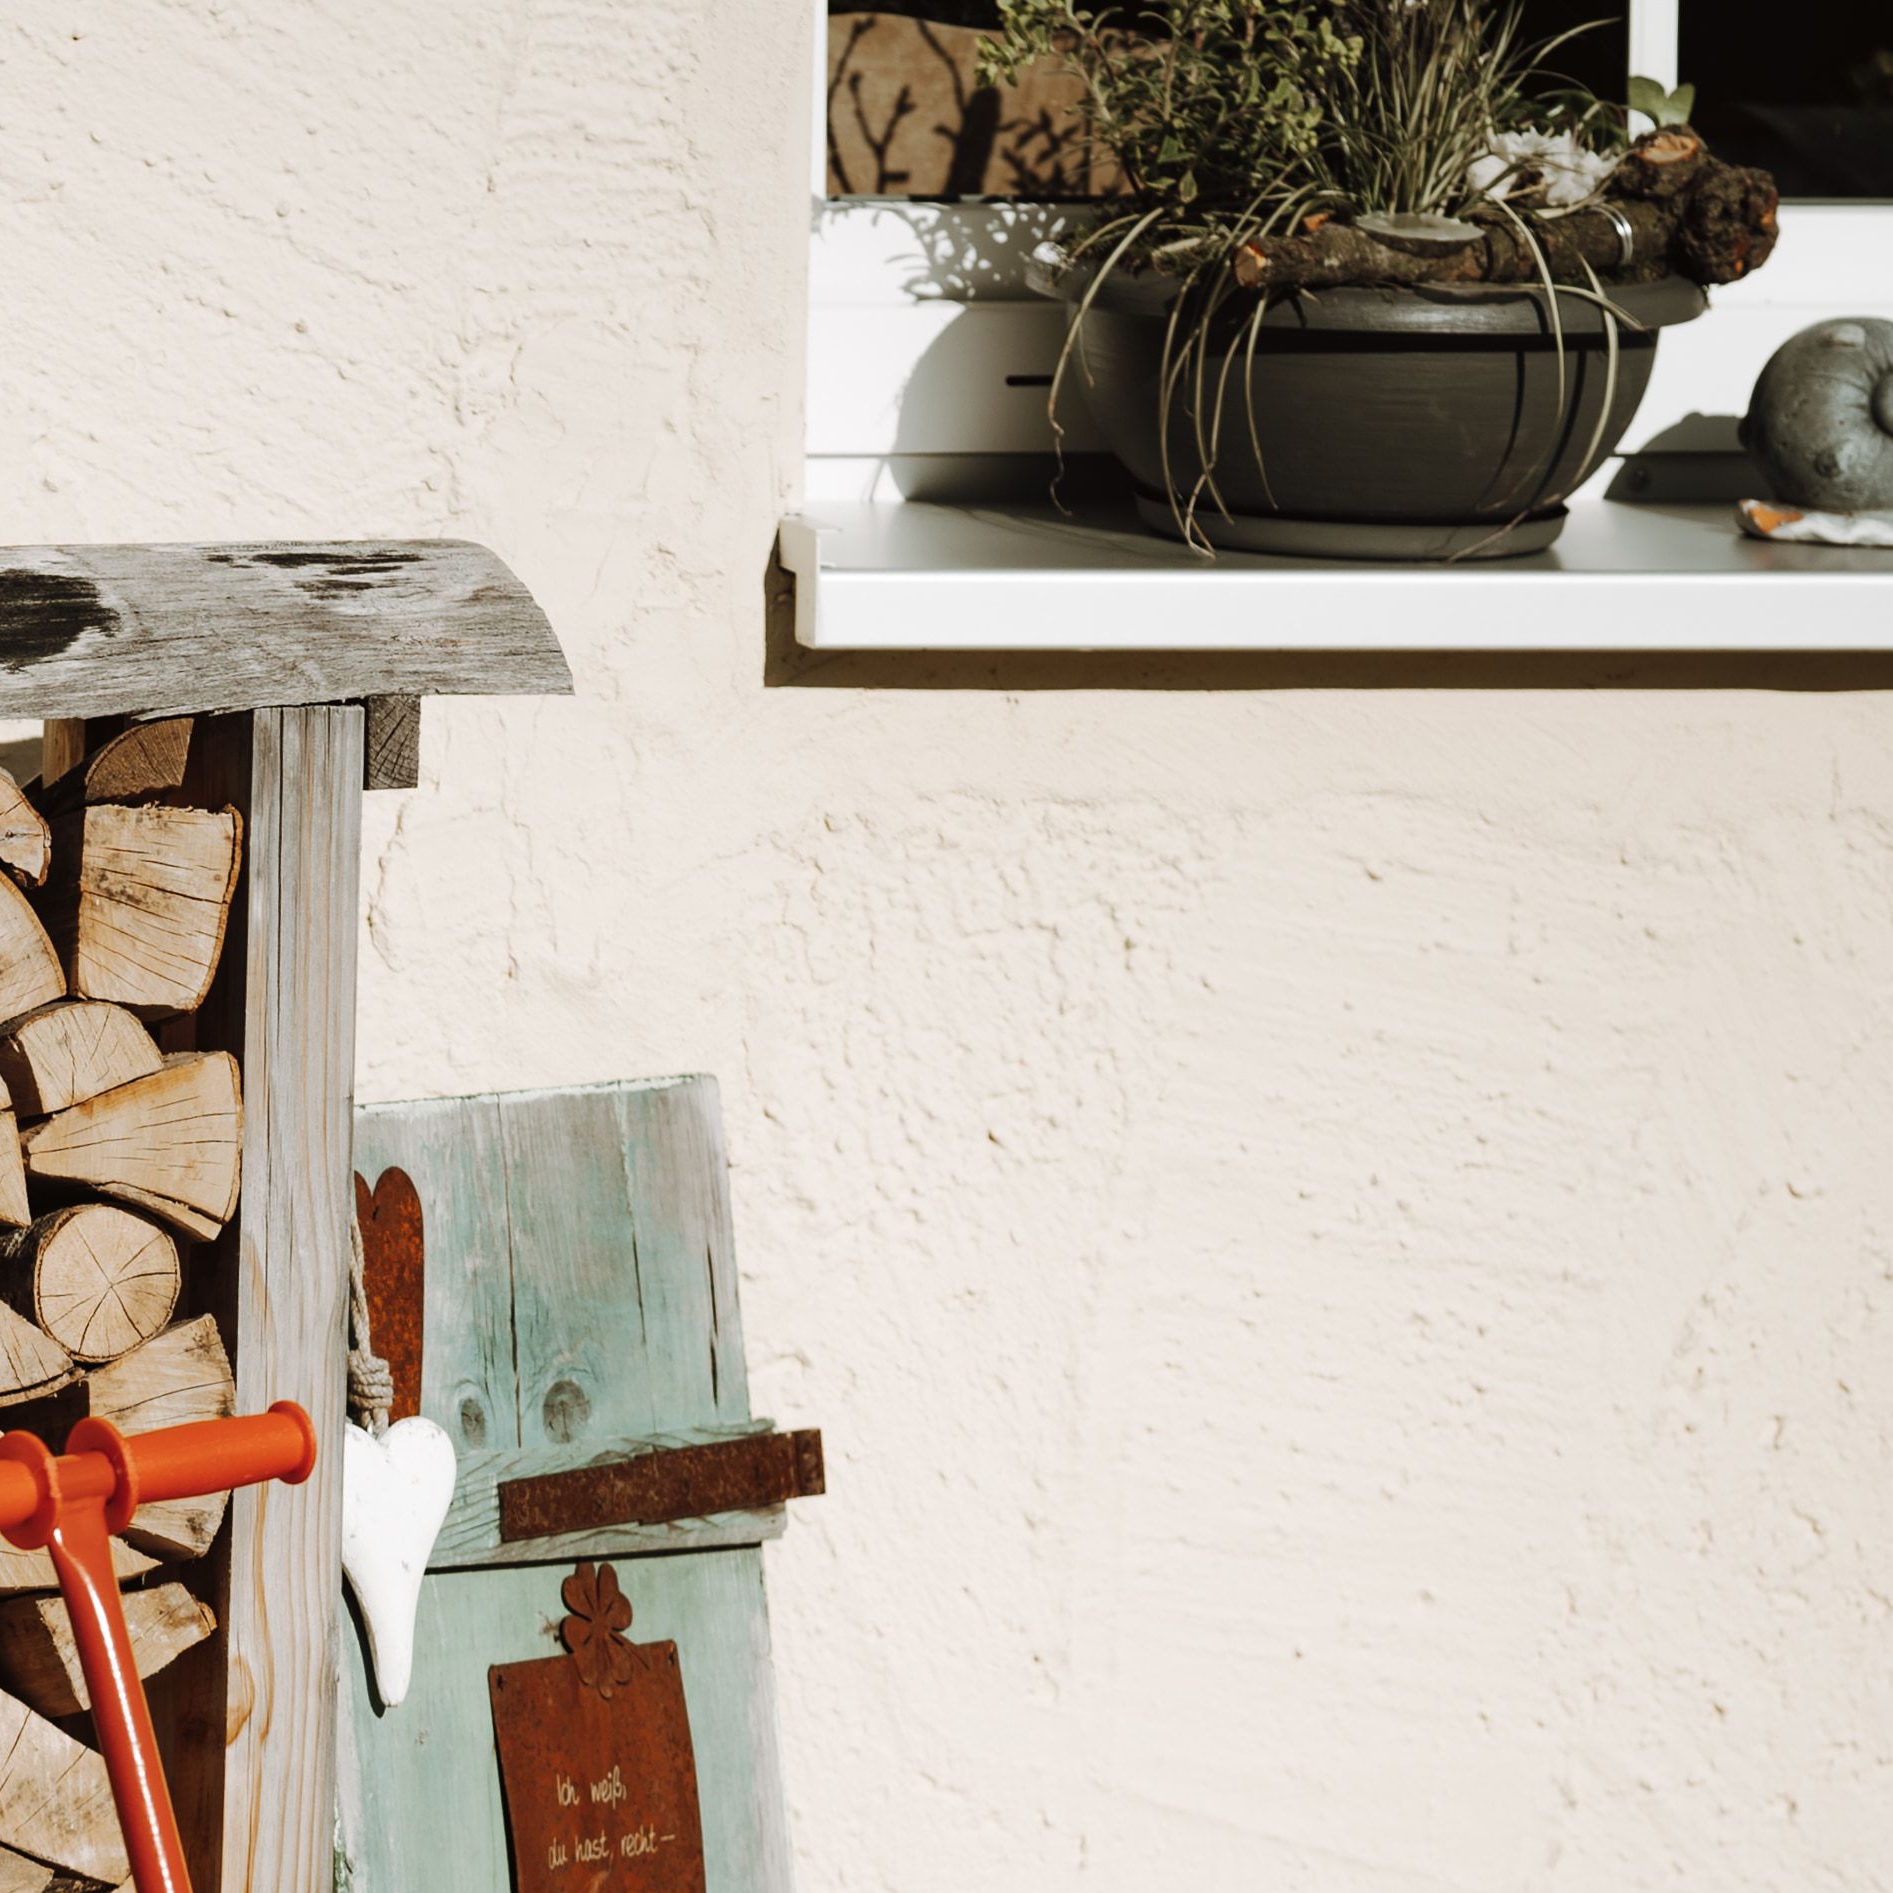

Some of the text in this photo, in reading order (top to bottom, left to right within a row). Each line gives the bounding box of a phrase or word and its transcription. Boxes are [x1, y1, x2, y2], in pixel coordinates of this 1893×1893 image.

[556, 1765, 627, 1810] Ich weiß,
[548, 1837, 567, 1870] du
